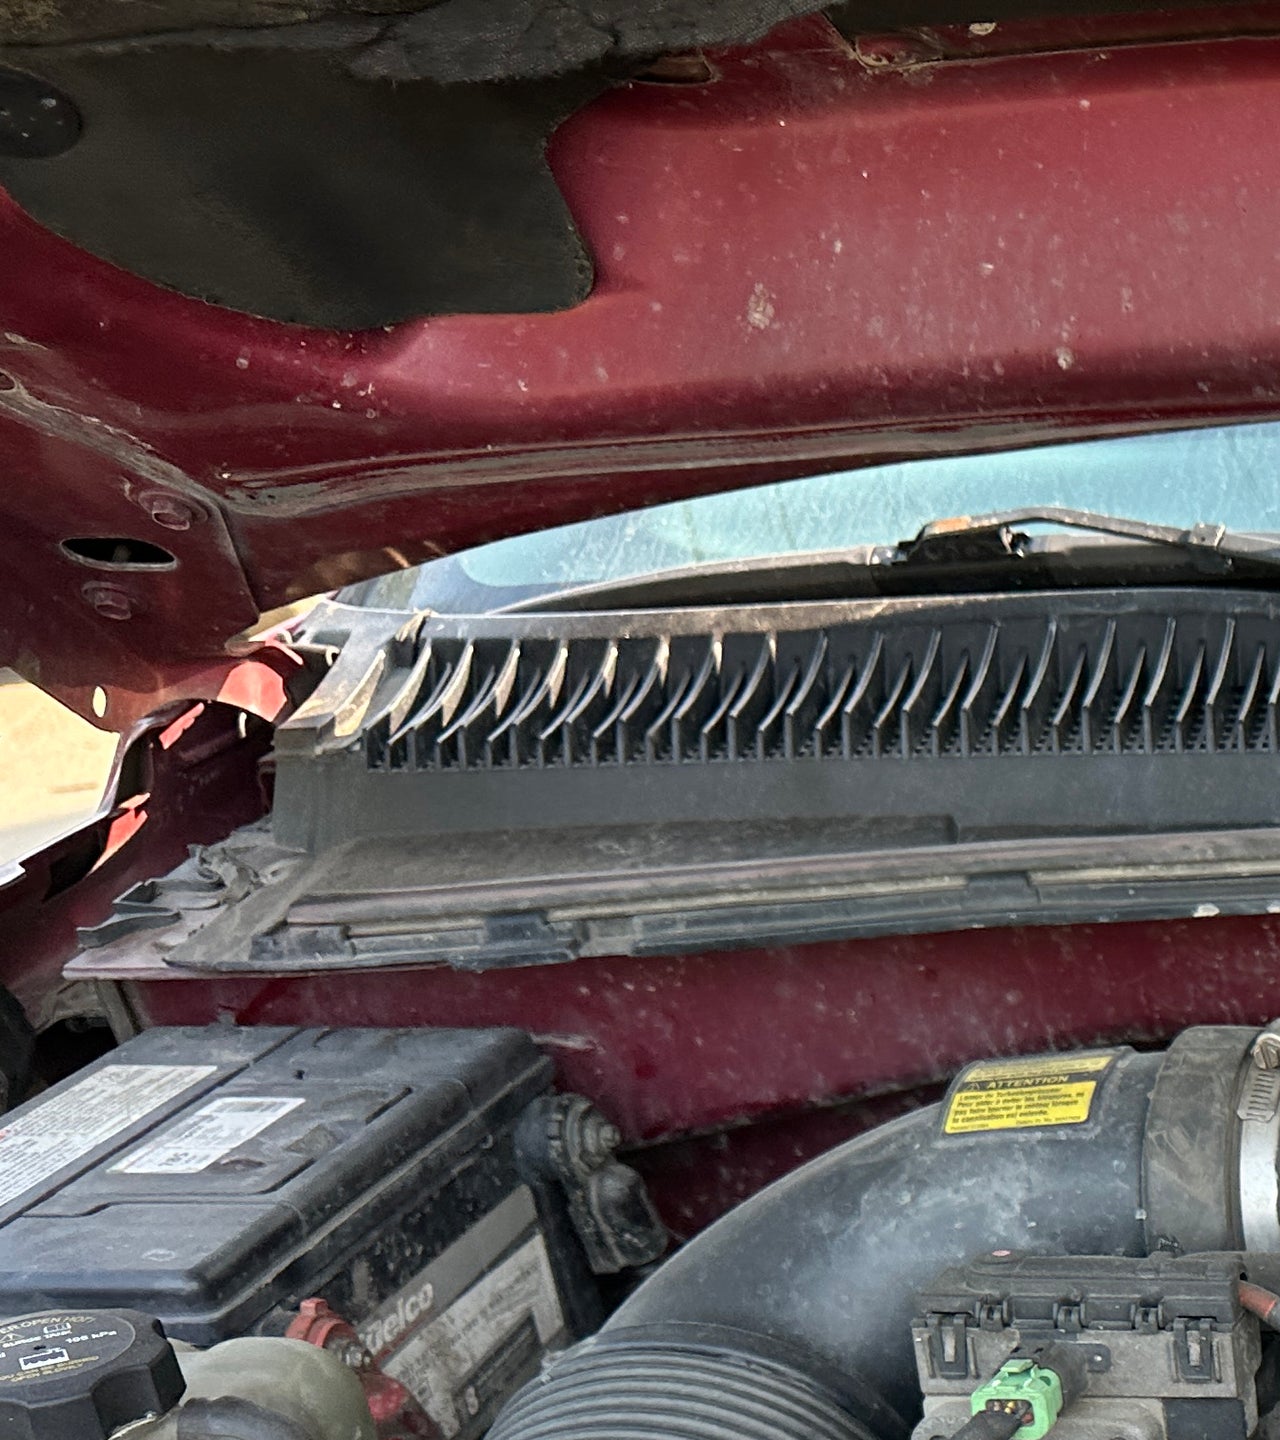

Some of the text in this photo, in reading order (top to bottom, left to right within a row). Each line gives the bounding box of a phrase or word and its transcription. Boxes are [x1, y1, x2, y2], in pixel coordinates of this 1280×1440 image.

[986, 1075, 1070, 1090] ATTENTION
[363, 1282, 434, 1356] Delco
[91, 1329, 118, 1340] kPa
